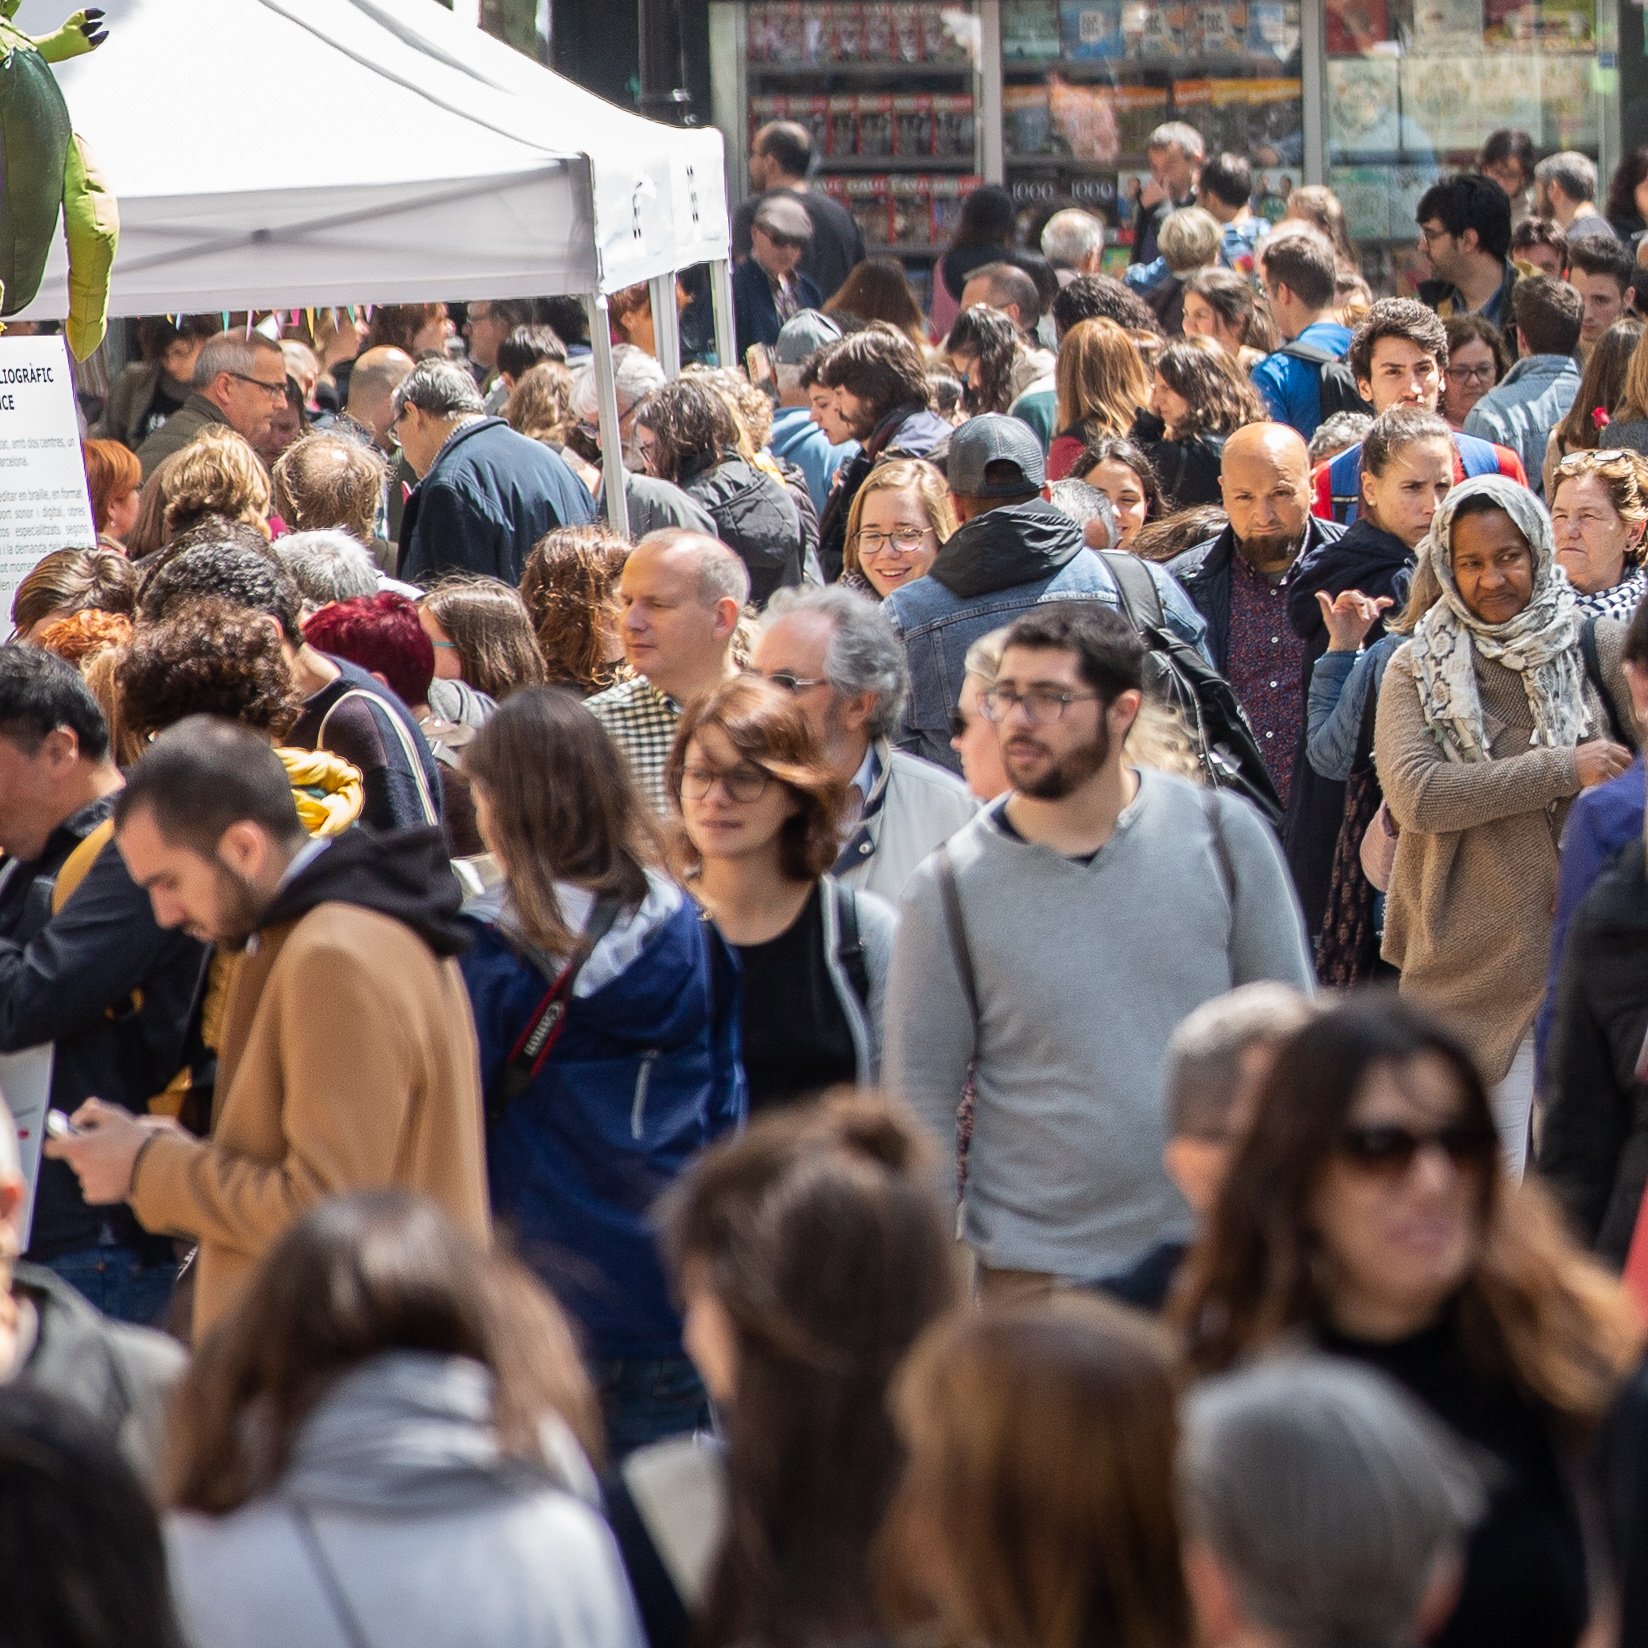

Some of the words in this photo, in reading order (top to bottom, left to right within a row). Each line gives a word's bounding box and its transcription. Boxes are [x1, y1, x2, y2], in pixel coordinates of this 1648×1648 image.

[1011, 182, 1054, 202] 1000
[1071, 181, 1114, 201] 1000
[0, 362, 54, 385] IOGRÀFIC
[0, 394, 15, 411] CE
[524, 1000, 565, 1057] Canon
